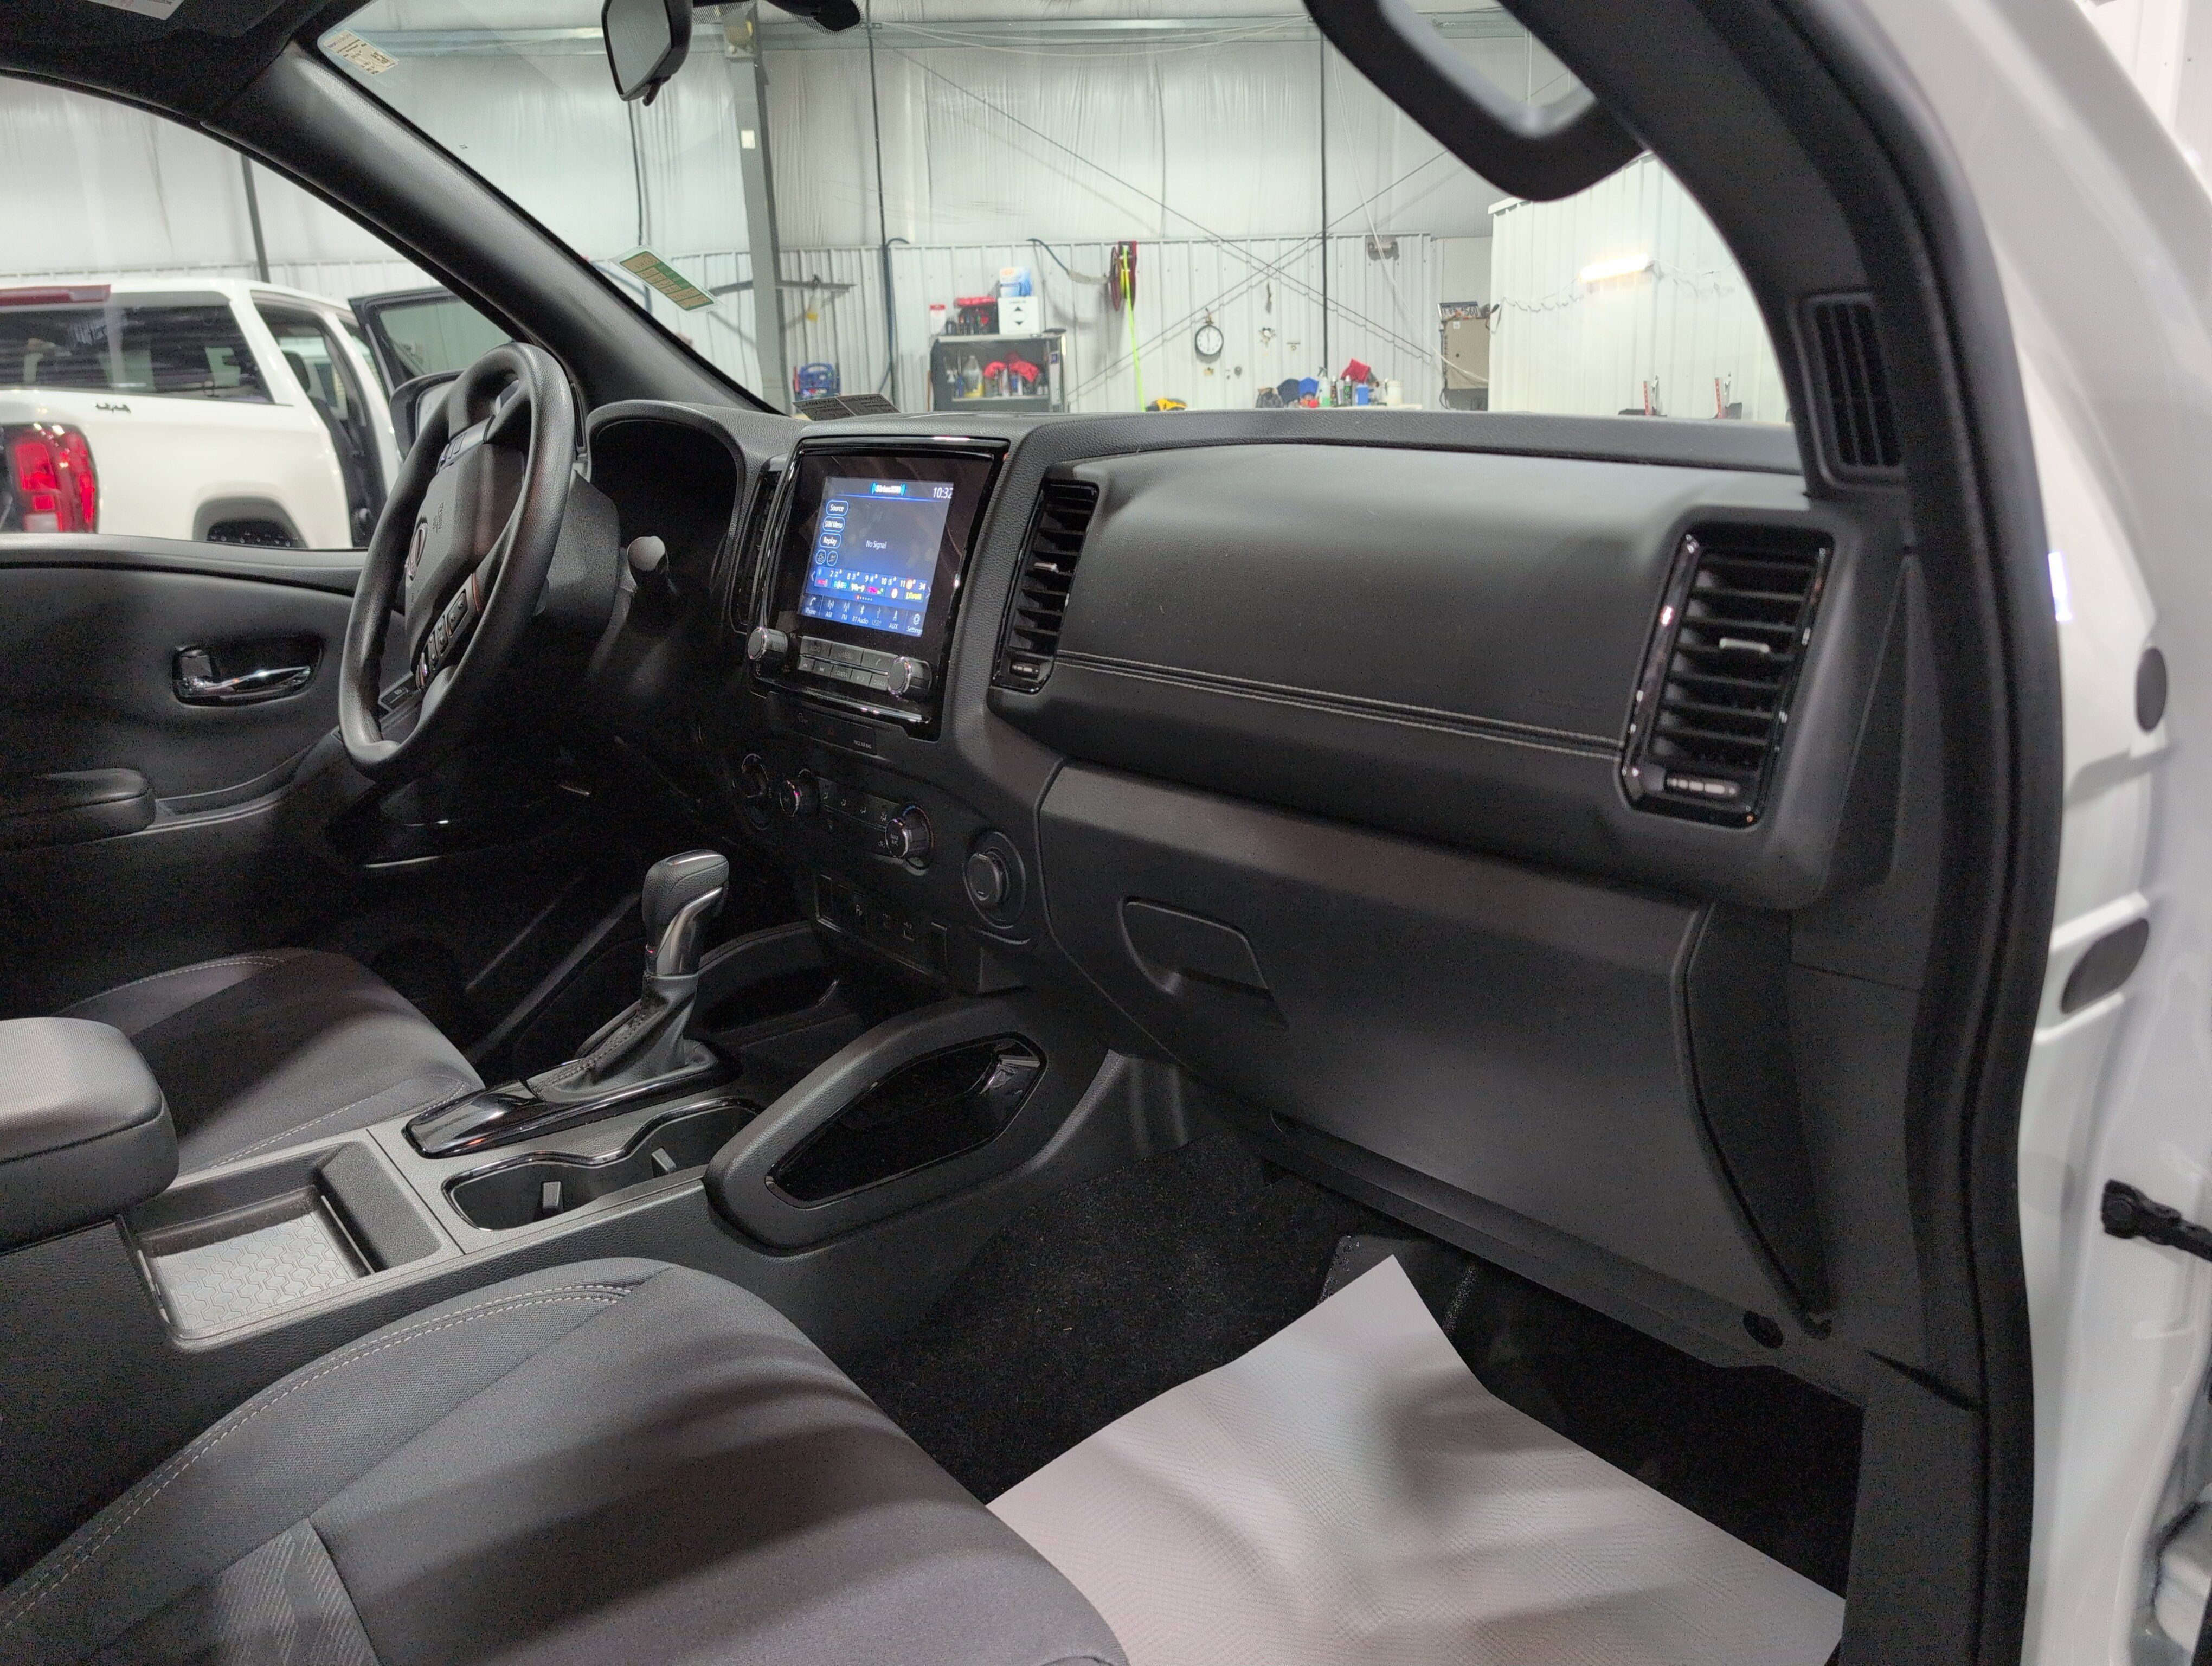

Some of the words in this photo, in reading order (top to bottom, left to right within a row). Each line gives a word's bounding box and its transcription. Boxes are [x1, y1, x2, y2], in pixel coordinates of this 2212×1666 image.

[933, 486, 954, 499] 10:32
[829, 504, 844, 512] Source
[823, 537, 837, 546] Replay
[872, 541, 887, 550] Signal
[805, 608, 816, 616] Phone
